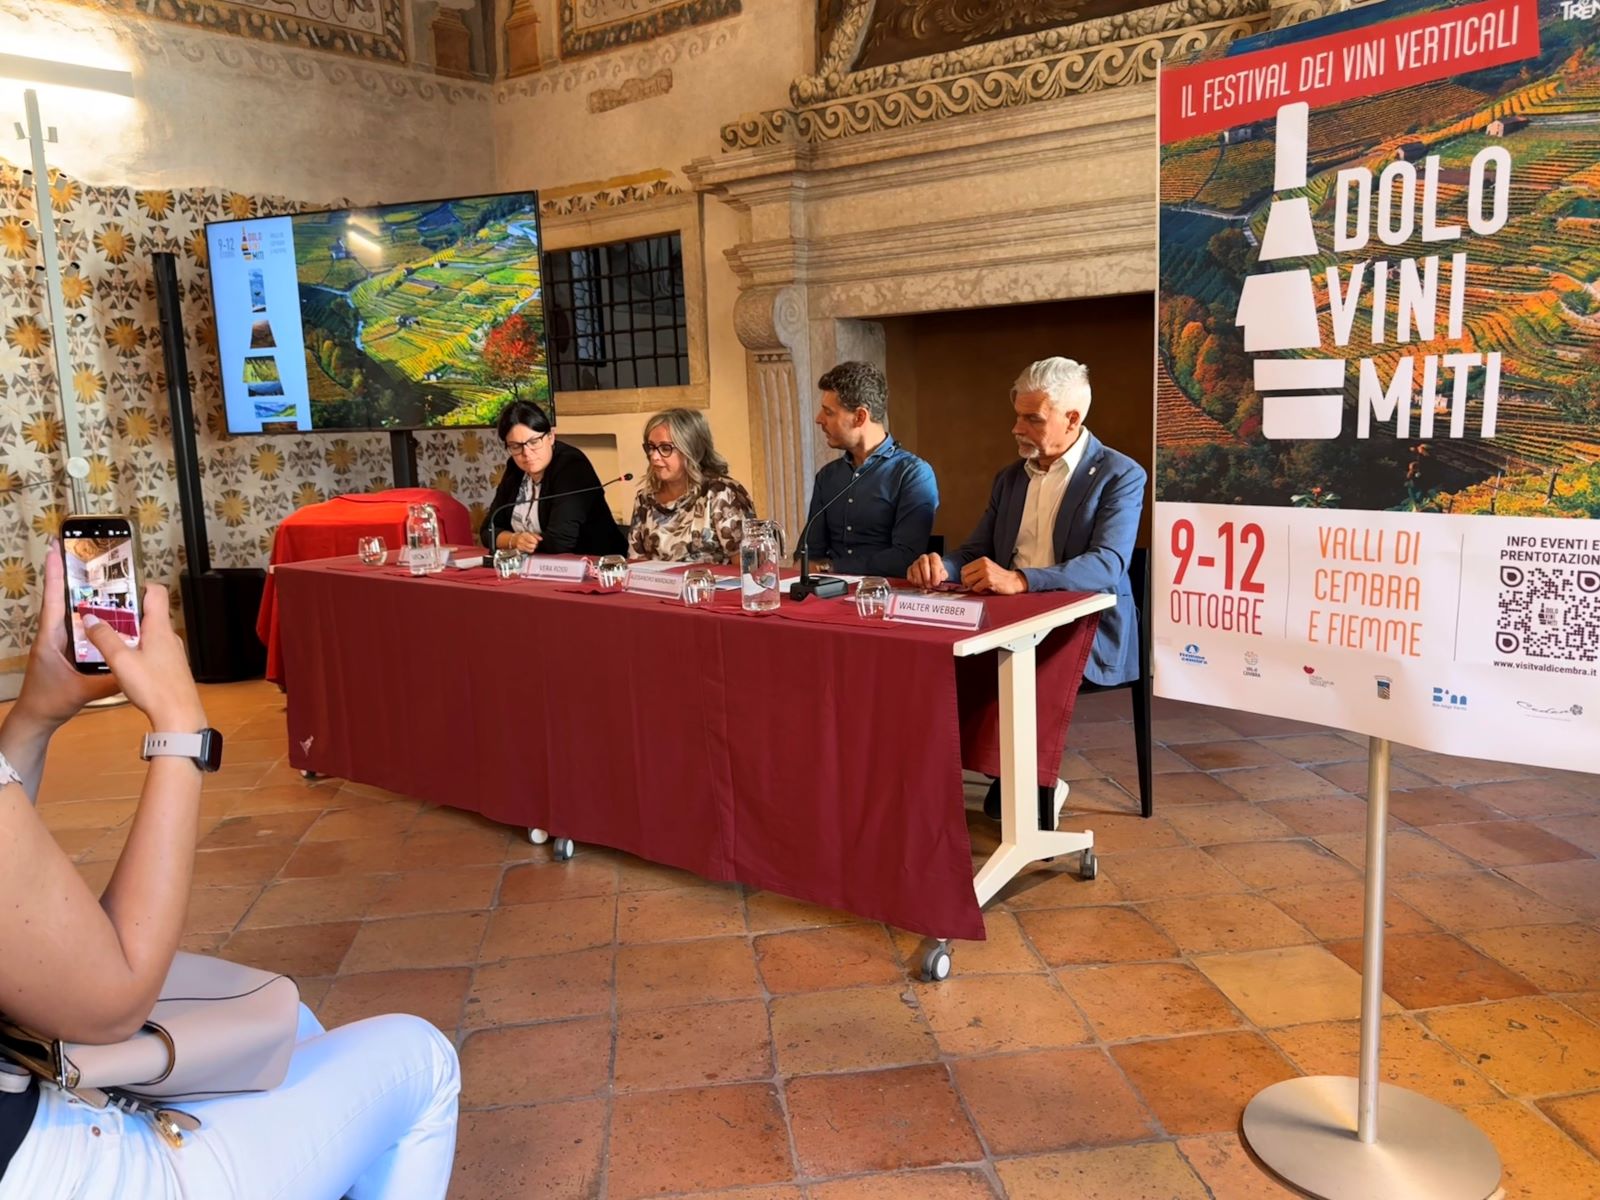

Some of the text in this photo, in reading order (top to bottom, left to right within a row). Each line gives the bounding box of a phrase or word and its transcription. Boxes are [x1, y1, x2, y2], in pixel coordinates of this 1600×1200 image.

[1181, 5, 1520, 119] IL FESTIVAL DEI VINI VERTICALI
[1334, 145, 1512, 252] DOLO
[1326, 252, 1467, 346] VINI
[1357, 351, 1502, 439] MITI
[1170, 518, 1265, 594] 9-12
[1318, 526, 1421, 565] VALLI DI
[1500, 549, 1600, 565] PRENTOTAZION
[1507, 536, 1600, 551] INFO EVENTI E
[899, 602, 965, 616] WALTER WEBBER
[1170, 589, 1264, 636] OTTOBRE
[1313, 568, 1421, 611] CEMBRA
[1308, 610, 1423, 657] E FIEMME
[1493, 660, 1597, 677] www.visitvaldicembra.it
